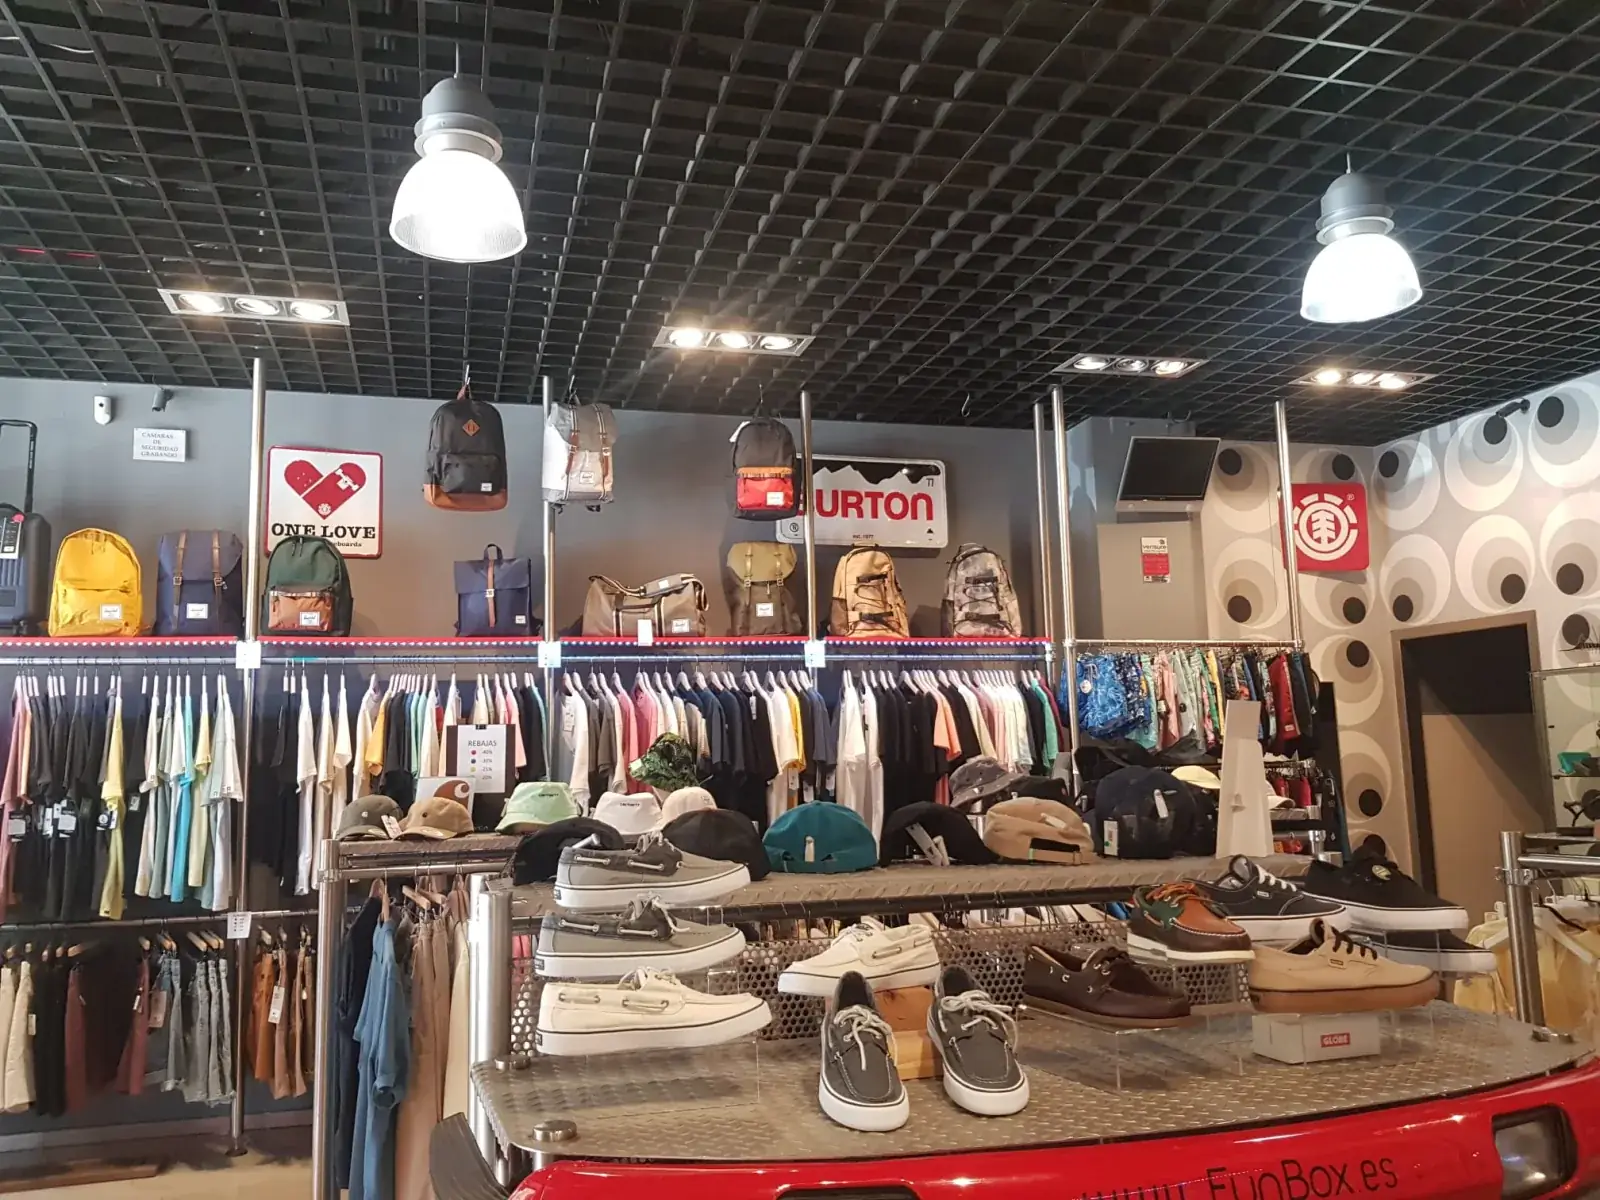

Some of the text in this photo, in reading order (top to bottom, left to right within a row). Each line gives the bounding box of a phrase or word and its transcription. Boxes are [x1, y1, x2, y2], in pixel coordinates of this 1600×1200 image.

[797, 489, 934, 521] URTON
[271, 523, 376, 539] ONE LOVE
[1082, 1158, 1398, 1200] FunBox.es
